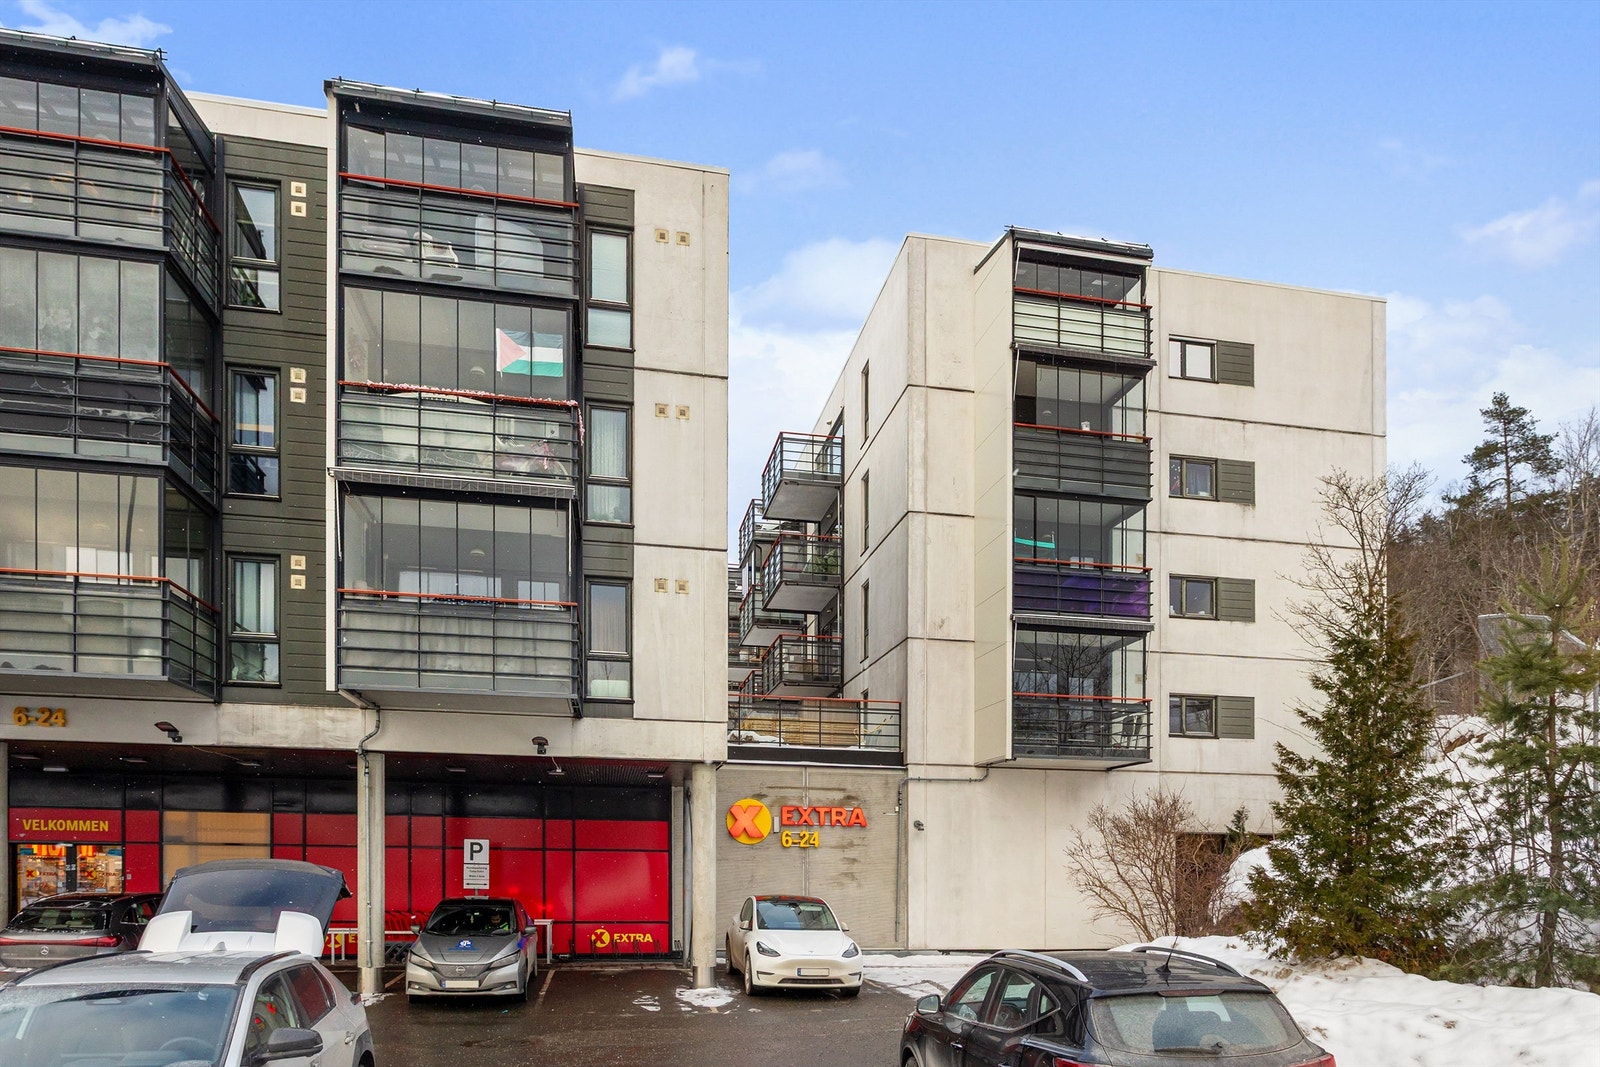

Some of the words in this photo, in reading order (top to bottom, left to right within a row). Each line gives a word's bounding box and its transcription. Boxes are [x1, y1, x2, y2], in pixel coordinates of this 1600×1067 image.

[13, 707, 67, 727] 6-24
[22, 819, 109, 832] VELKOMMEN
[728, 804, 765, 839] X
[781, 806, 867, 827] EXTRA
[781, 829, 820, 849] 6-24
[469, 841, 484, 861] P
[613, 933, 653, 943] EXTRA
